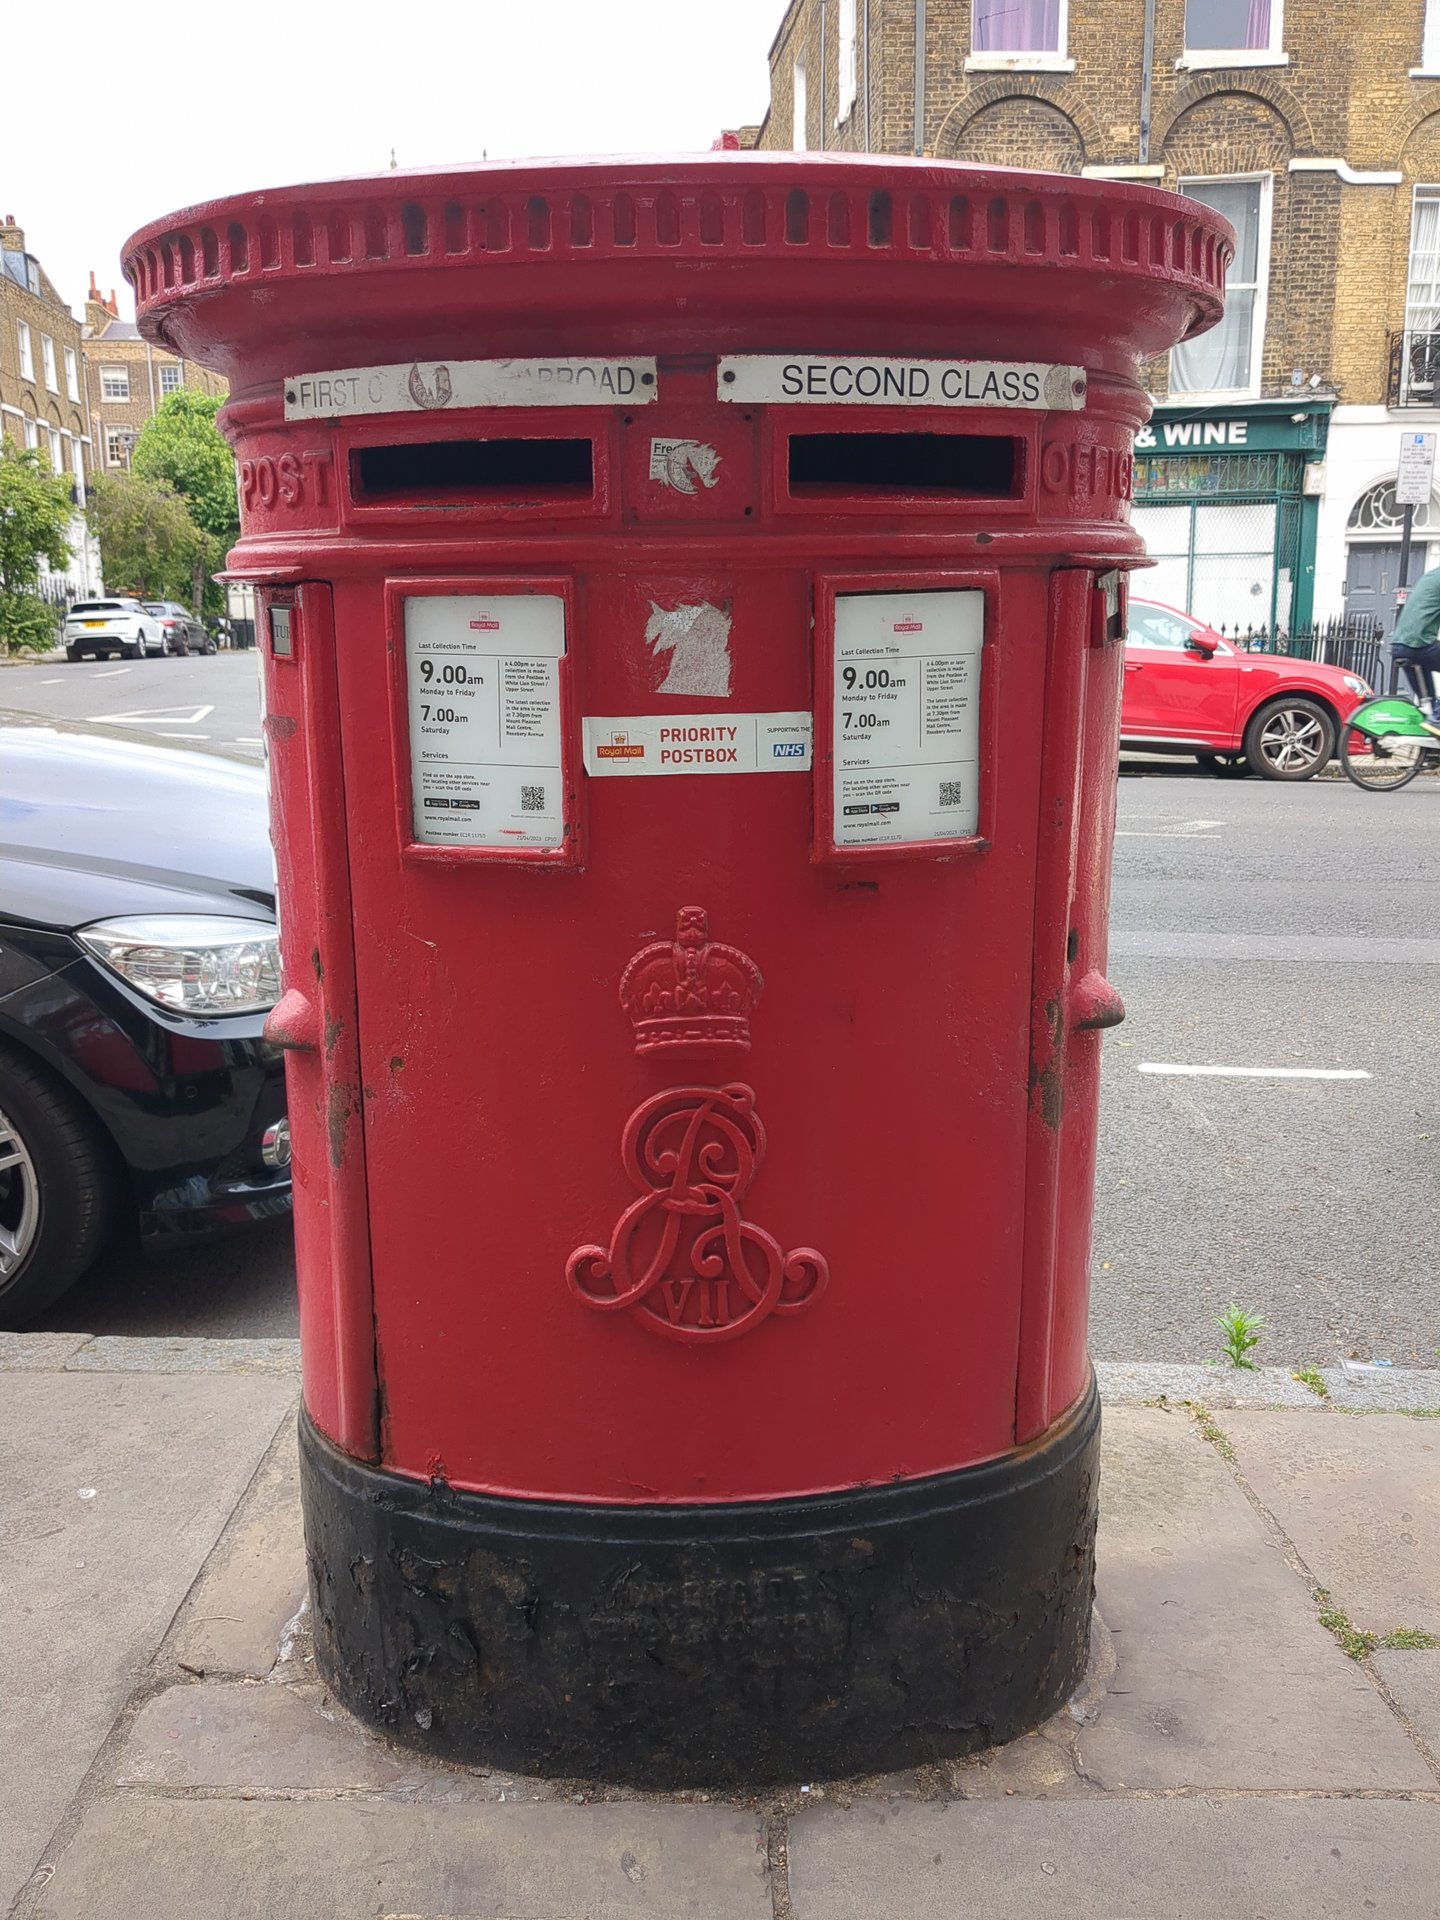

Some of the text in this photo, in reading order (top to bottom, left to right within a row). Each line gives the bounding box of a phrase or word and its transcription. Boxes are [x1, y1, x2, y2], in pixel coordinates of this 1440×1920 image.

[781, 363, 1040, 402] SECOND CLASS
[300, 377, 360, 408] FIRST
[1134, 421, 1248, 448] & WINE
[241, 449, 334, 511] POST
[420, 660, 484, 685] 9.00am
[843, 666, 906, 690] 9.00am
[420, 688, 445, 696] Monday
[455, 689, 476, 697] Friday
[842, 694, 867, 702] Monday
[877, 692, 898, 700] Friday
[420, 705, 468, 722] 7.00am
[842, 712, 890, 729] 7.00am
[421, 725, 450, 735] Saturday
[660, 726, 738, 743] PRIORITY
[842, 733, 872, 741] Saturday
[422, 751, 449, 759] Services
[599, 746, 642, 757] Royal Mail
[660, 748, 738, 764] POSTBOX
[774, 744, 804, 756] NHS
[843, 820, 892, 828] www.royalmail.com
[661, 1279, 731, 1325] VII
